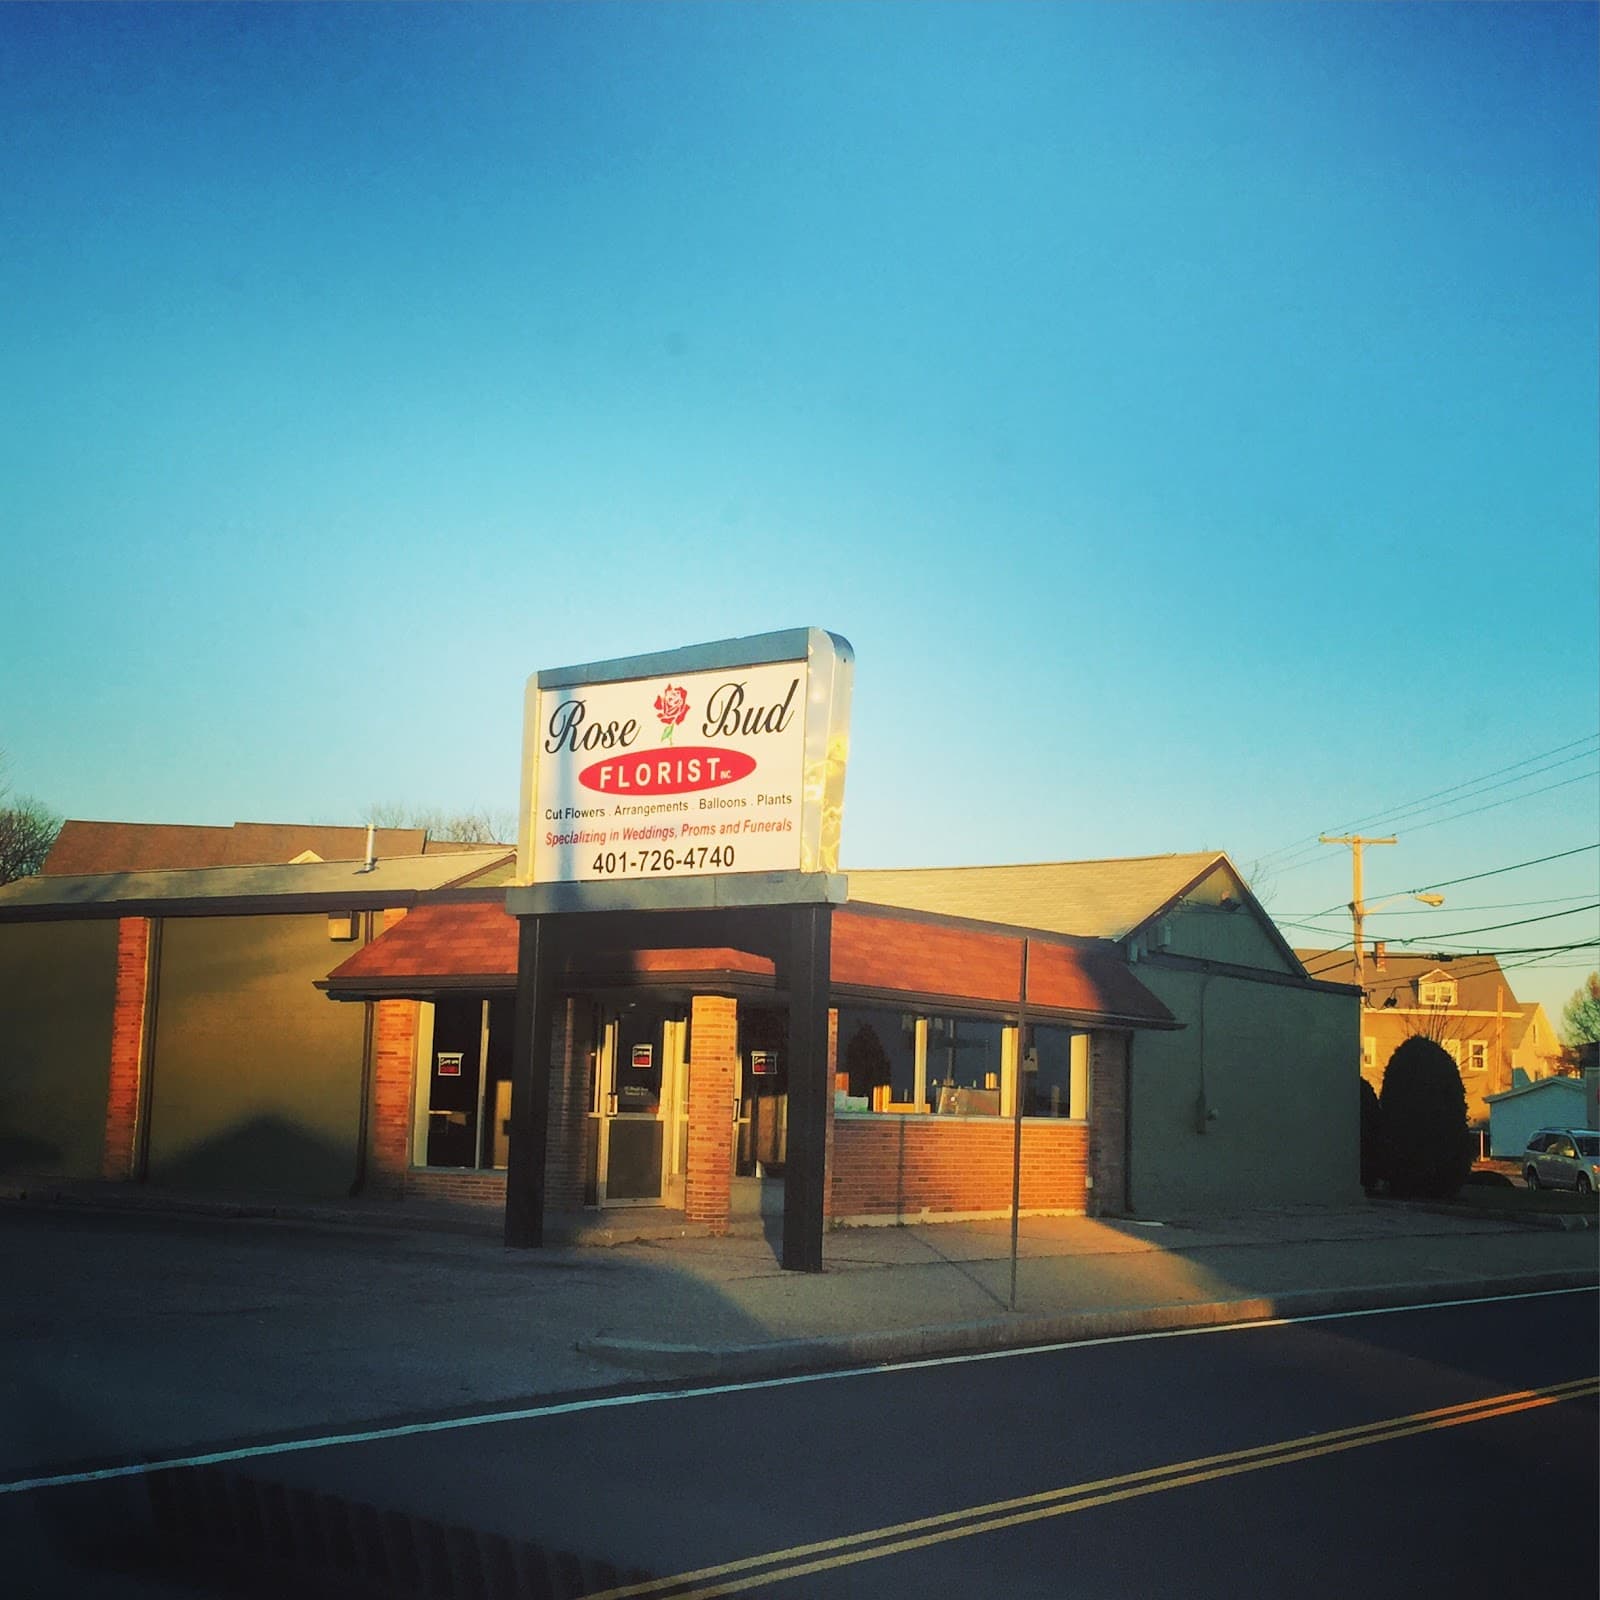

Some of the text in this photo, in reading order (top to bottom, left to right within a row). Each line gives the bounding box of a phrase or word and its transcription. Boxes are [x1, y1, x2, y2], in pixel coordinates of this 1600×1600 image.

[545, 678, 799, 754] Rose Bud
[599, 757, 721, 789] FLORIST
[545, 794, 792, 820] Cut Flowers Arrangements Balloons Plants
[545, 818, 792, 847] Specializing in Weddings, Proms and Funerals
[592, 845, 735, 874] 401-726-4740
